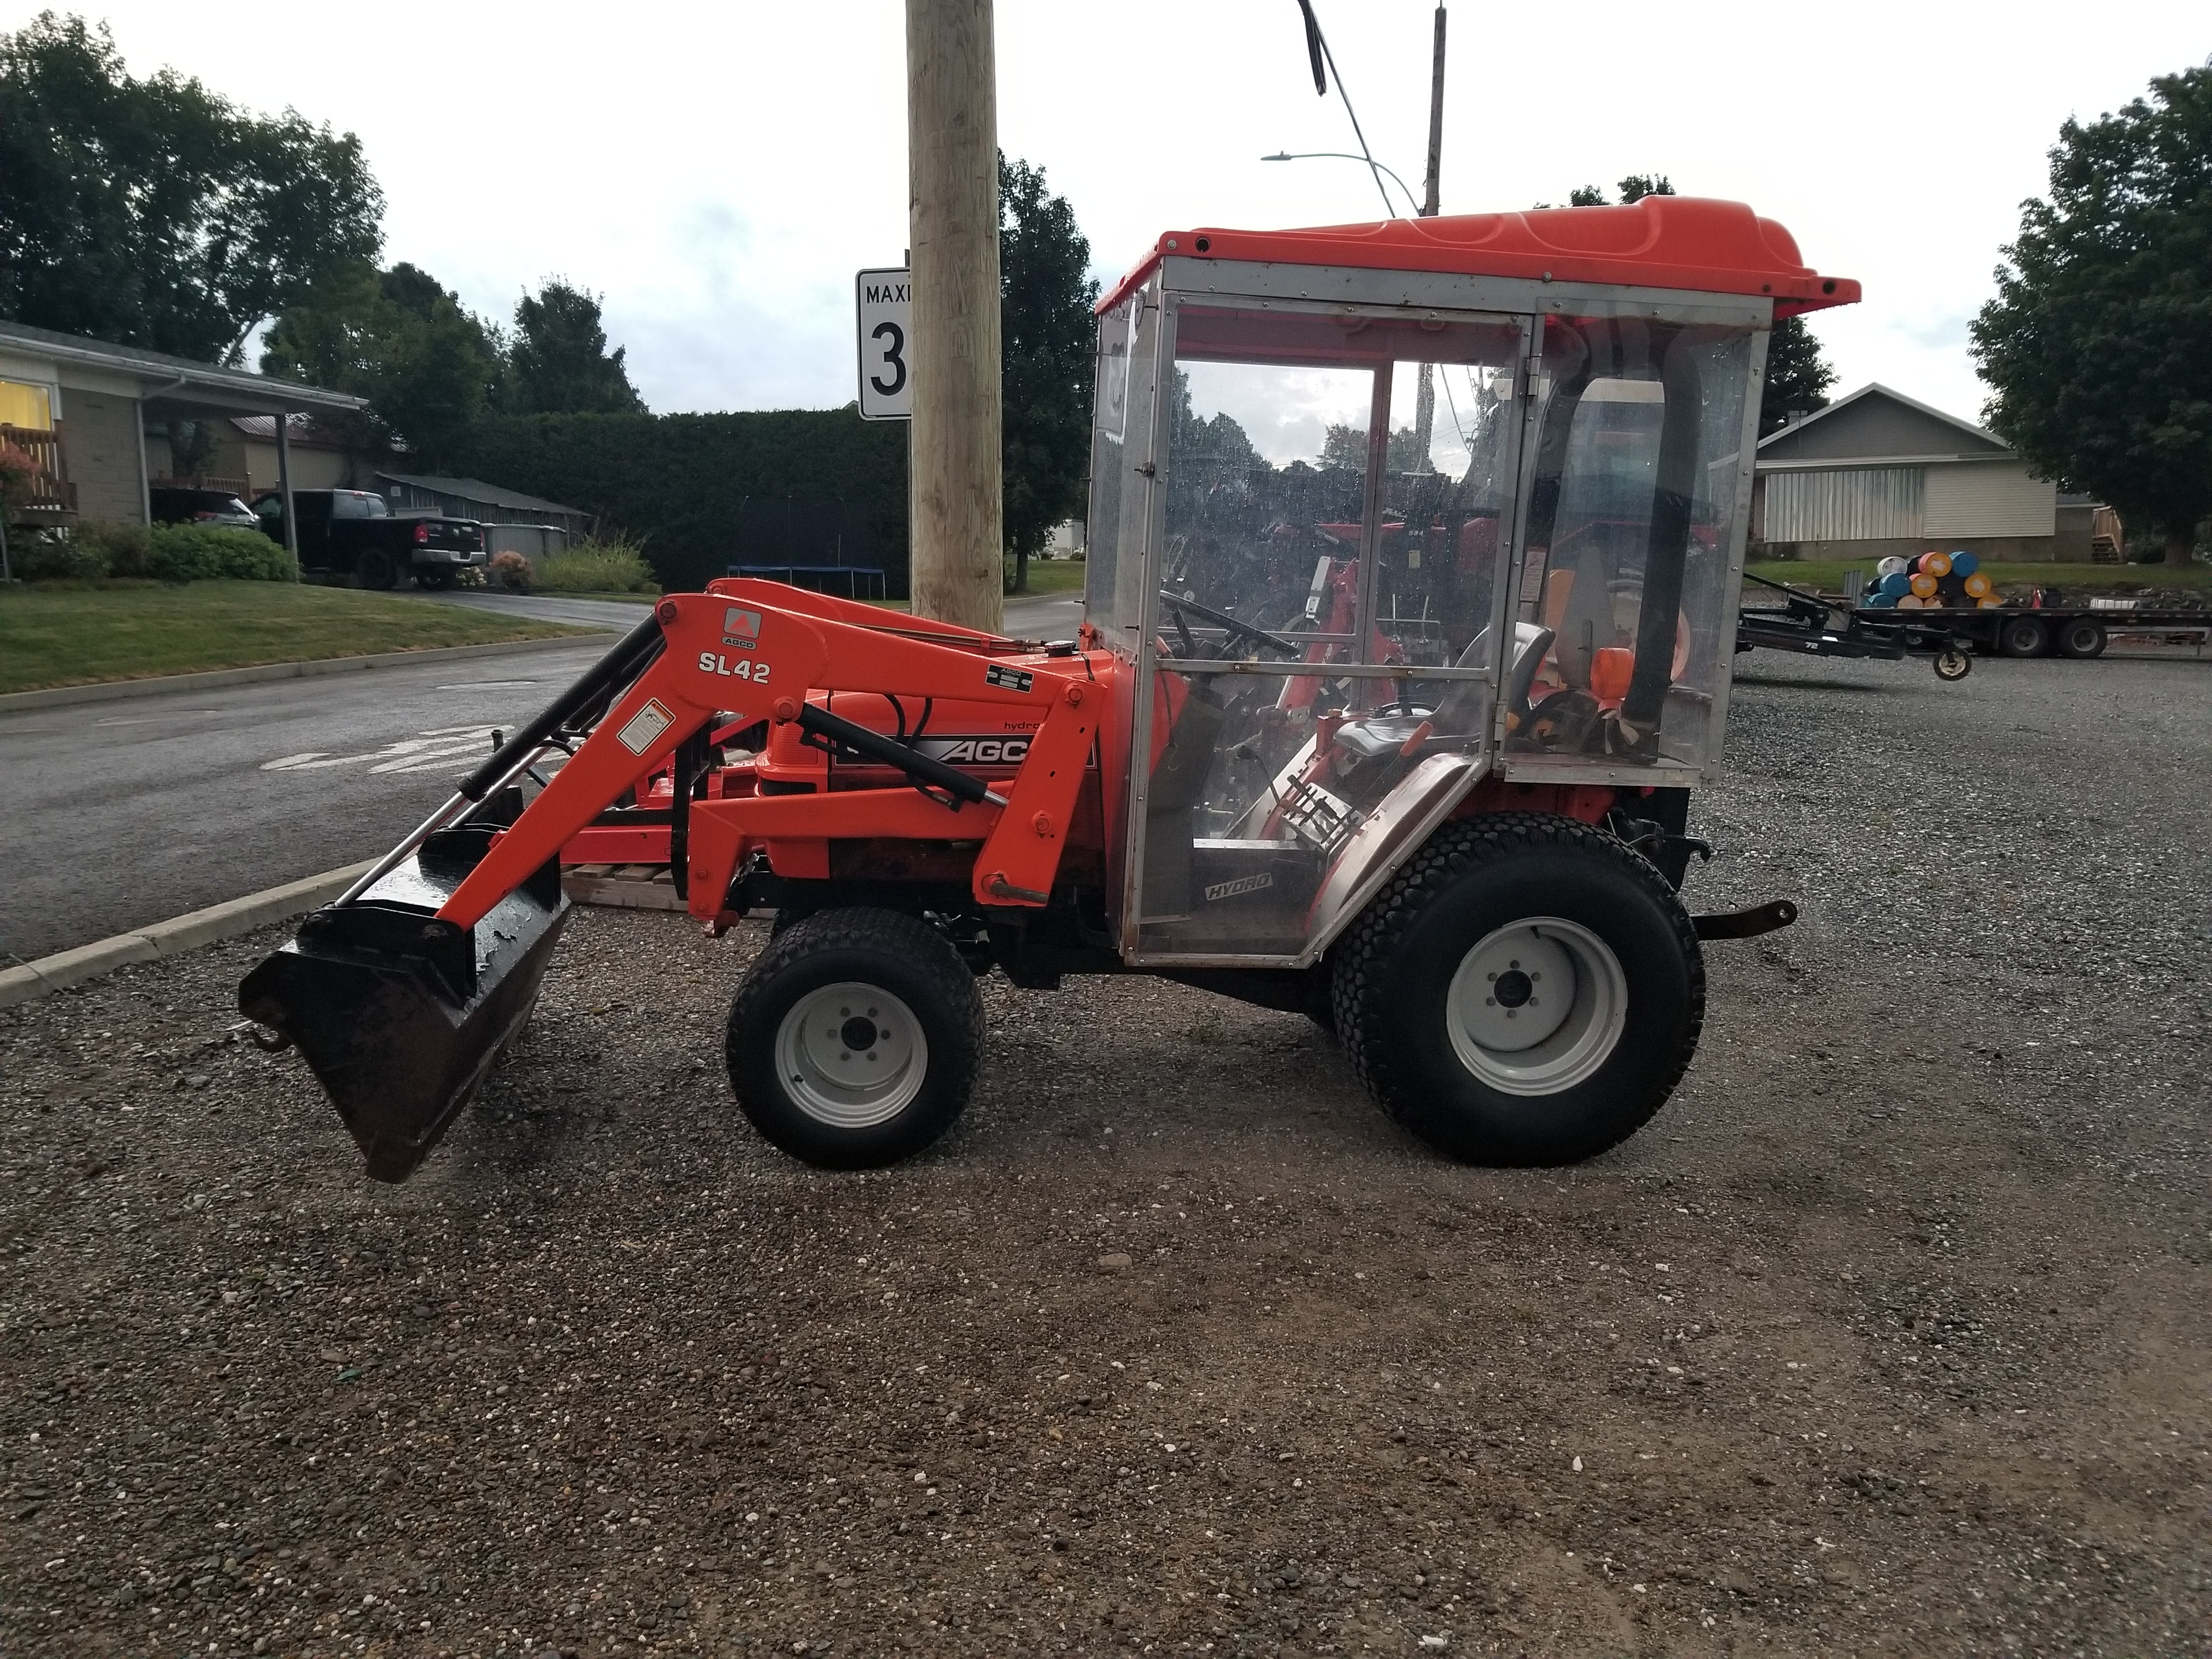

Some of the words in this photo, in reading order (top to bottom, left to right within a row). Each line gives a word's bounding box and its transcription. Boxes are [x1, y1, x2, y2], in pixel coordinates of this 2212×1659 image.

[866, 284, 911, 303] MAXI
[870, 321, 906, 396] 3
[725, 638, 754, 648] AGCO
[1805, 641, 1819, 650] 72
[698, 651, 771, 684] SL42
[1005, 721, 1040, 730] hydro
[938, 741, 1028, 761] AGC
[1208, 874, 1271, 899] HYDRO
